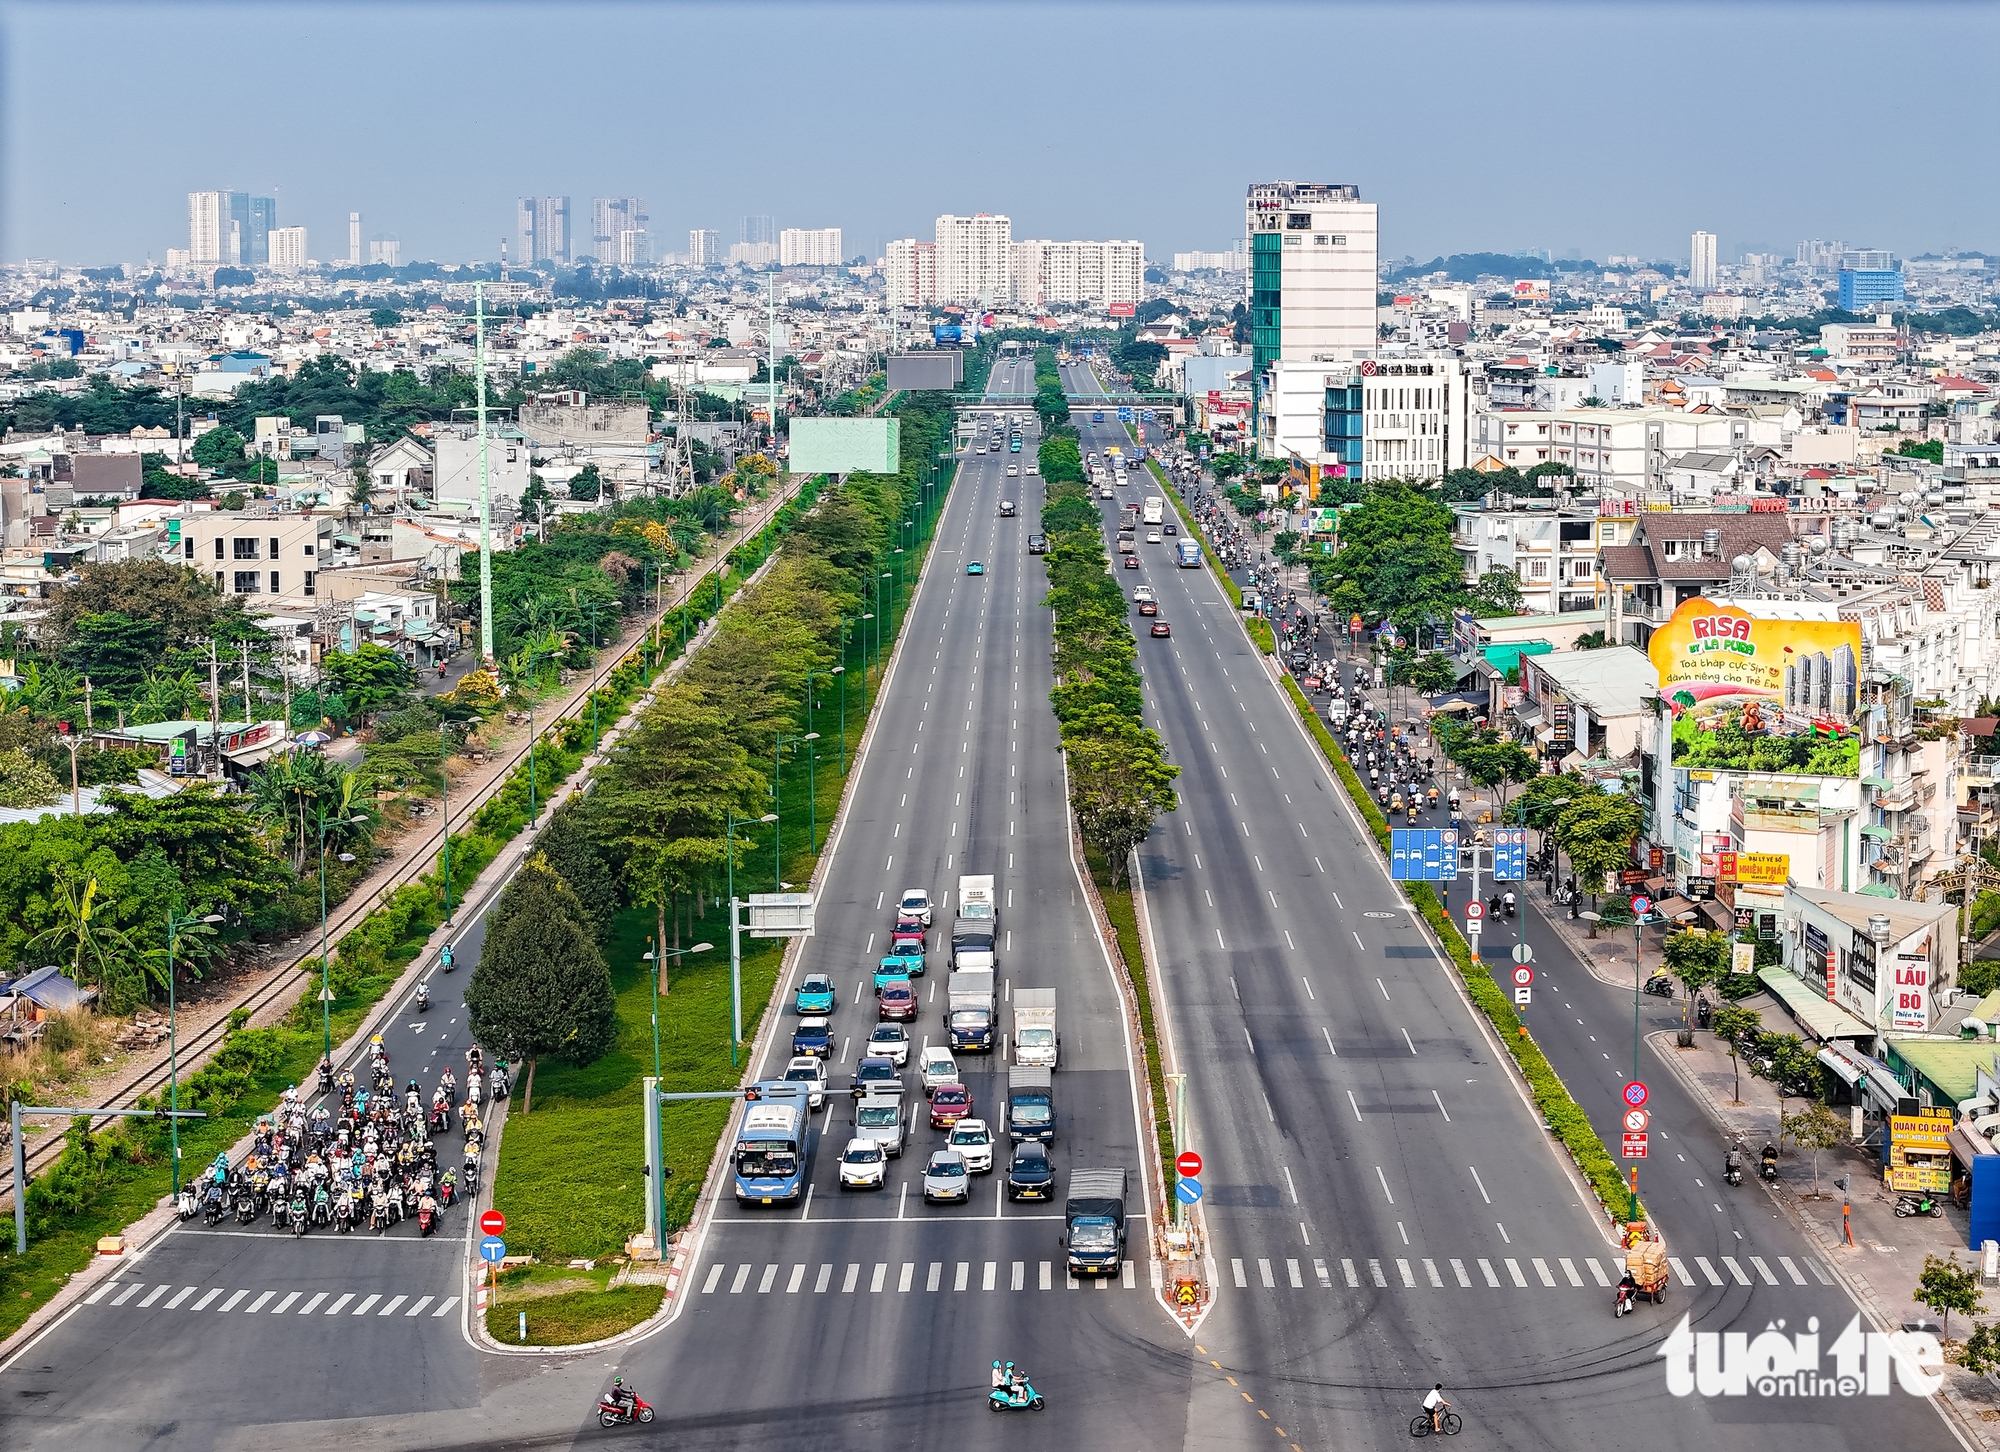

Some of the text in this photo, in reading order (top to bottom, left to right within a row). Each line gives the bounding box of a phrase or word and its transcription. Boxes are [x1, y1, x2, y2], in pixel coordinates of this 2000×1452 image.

[1380, 363, 1434, 374] SeABank
[1600, 500, 1639, 515] HOTEL
[1752, 498, 1790, 513] HOTEL
[1799, 497, 1857, 510] HOTEL
[1692, 617, 1750, 641] RISA
[1704, 639, 1719, 650] LA
[1723, 639, 1756, 656] PURA
[1666, 672, 1692, 683] dành
[1694, 672, 1720, 684] riêng
[1723, 673, 1742, 682] cho
[1764, 680, 1779, 690] Em
[1765, 864, 1787, 876] PHÁT
[1471, 906, 1479, 914] 80
[1853, 934, 1866, 958] 24h
[1806, 948, 1818, 968] 24h
[1518, 972, 1527, 980] 60
[1895, 963, 1926, 987] LẨU
[1899, 990, 1922, 1010] BÒ
[1895, 1010, 1912, 1019] Thiện
[1920, 1106, 1935, 1117] TRÀ
[1893, 1120, 1916, 1131] QUÁN
